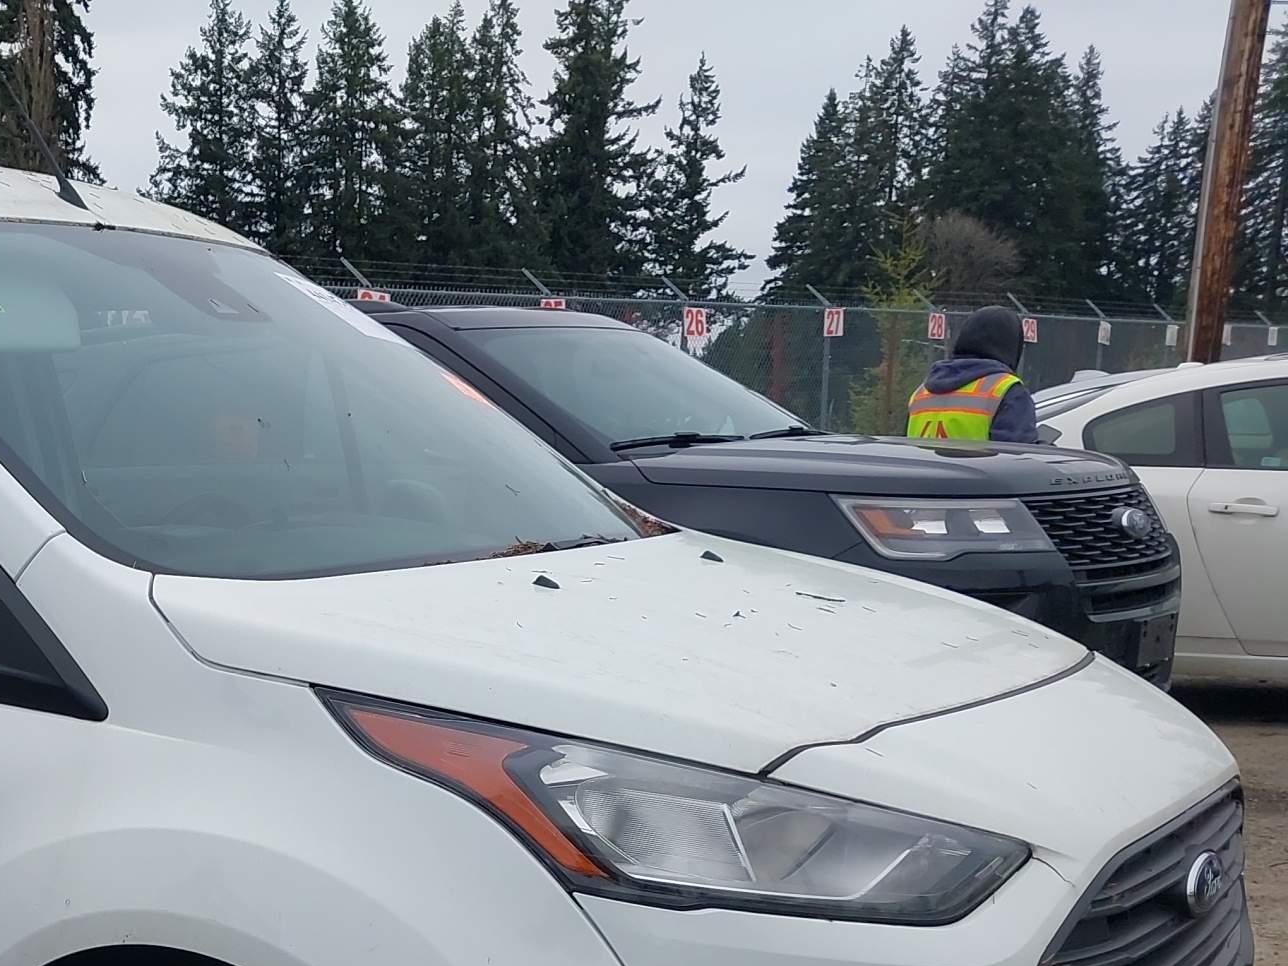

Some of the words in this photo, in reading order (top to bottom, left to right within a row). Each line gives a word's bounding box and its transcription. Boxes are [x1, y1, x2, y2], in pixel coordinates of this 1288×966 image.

[685, 309, 705, 336] 26
[826, 308, 842, 335] 27
[929, 313, 944, 338] 28
[1023, 319, 1037, 341] 29
[1049, 471, 1129, 486] EXPLO
